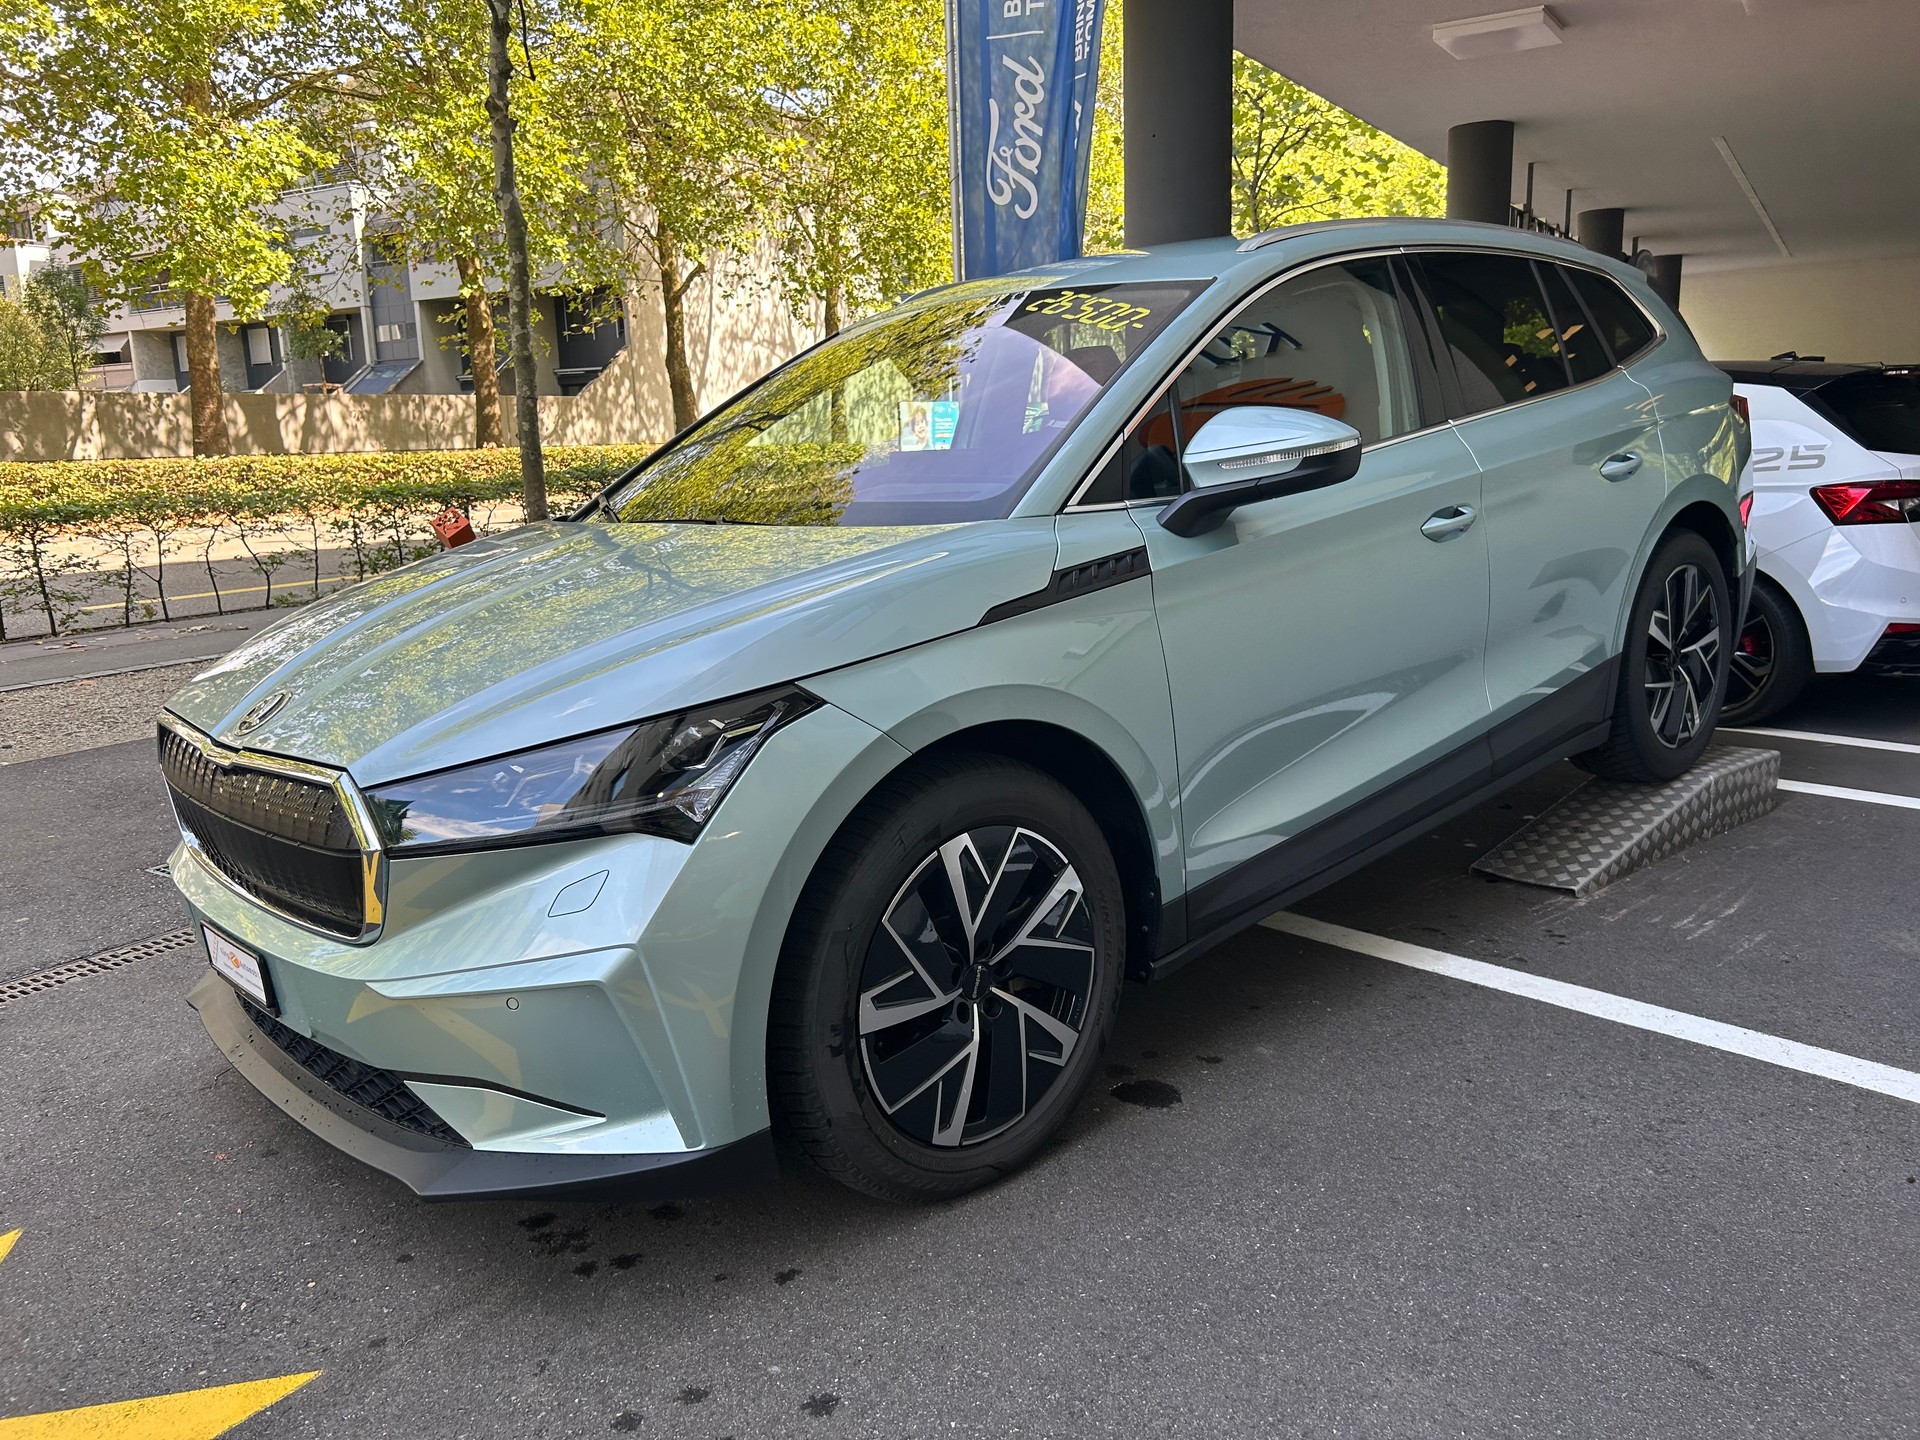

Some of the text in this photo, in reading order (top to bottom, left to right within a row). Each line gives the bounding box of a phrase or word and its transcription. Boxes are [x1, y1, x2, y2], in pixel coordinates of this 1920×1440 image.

[1075, 0, 1085, 62] BRIN
[986, 54, 1045, 220] Ford
[1752, 444, 1827, 472] 25
